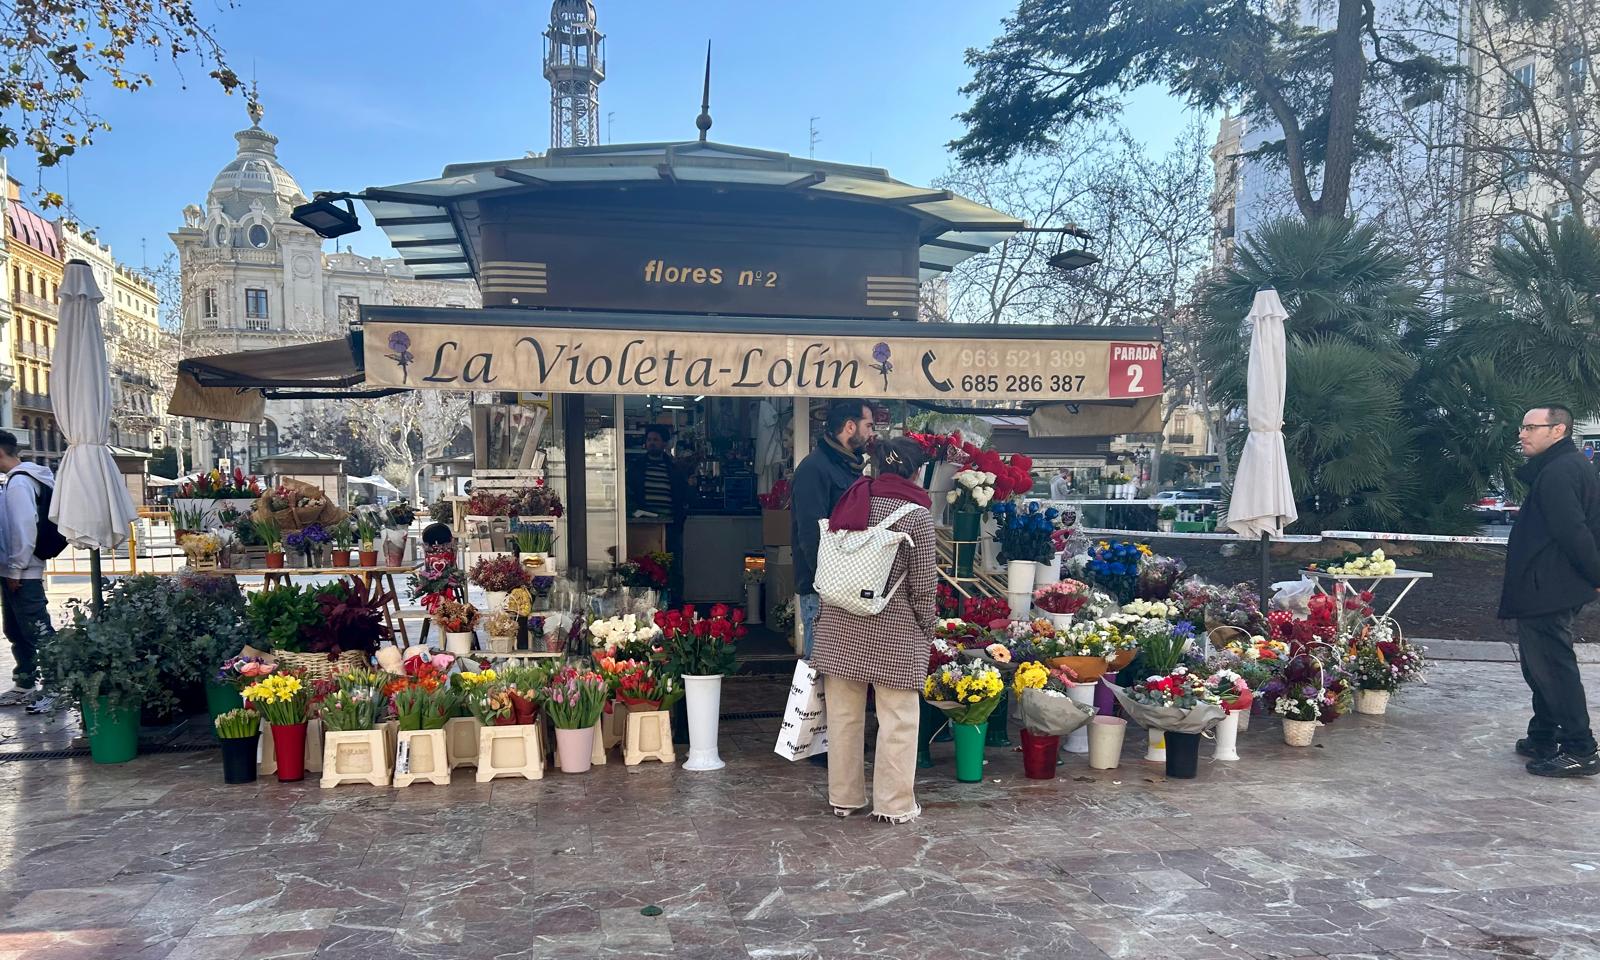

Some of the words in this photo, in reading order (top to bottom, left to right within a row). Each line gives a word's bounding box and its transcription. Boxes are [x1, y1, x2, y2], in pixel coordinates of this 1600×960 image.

[644, 260, 723, 284] flores
[422, 341, 498, 384] La
[961, 349, 999, 368] 963
[1006, 349, 1042, 368] 521
[1050, 349, 1086, 368] 399
[1114, 346, 1157, 361] PARADA
[961, 375, 999, 393] 685
[1005, 375, 1043, 393] 286
[1050, 375, 1086, 393] 387
[1127, 364, 1145, 393] 2
